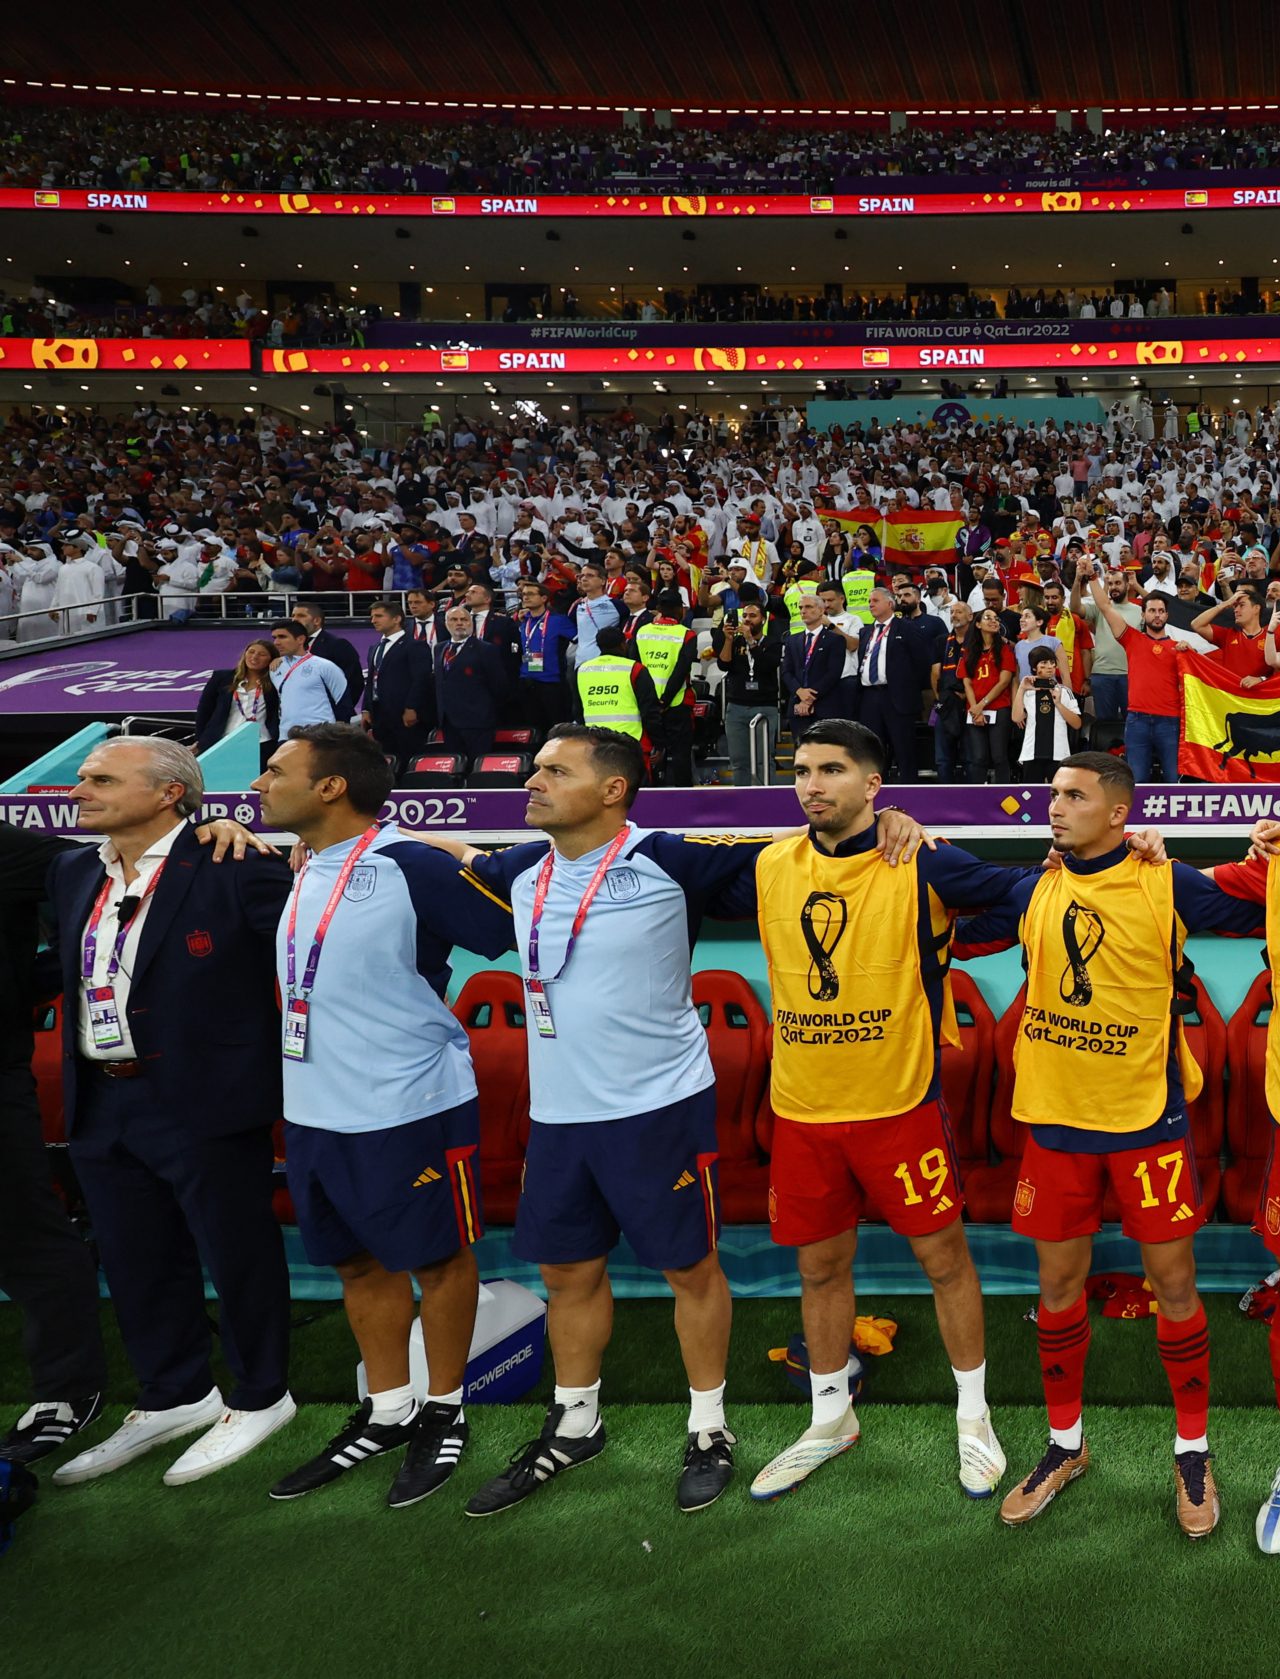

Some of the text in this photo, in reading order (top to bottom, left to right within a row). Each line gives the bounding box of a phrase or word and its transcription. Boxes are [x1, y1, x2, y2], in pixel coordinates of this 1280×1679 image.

[1049, 179, 1057, 187] is
[1058, 178, 1071, 187] all
[87, 194, 147, 208] SPAIN
[482, 199, 537, 212] SPAIN
[859, 198, 913, 211] SPAIN
[530, 327, 638, 341] #FIFAWorldCup
[866, 324, 1069, 339] FIFA WORLD CUP Qatar2022
[500, 353, 565, 368] SPAIN
[920, 349, 984, 365] SPAIN
[588, 685, 619, 695] 2950
[0, 804, 45, 828] IFA
[778, 1009, 891, 1026] FIFA WORLD CUP
[1048, 1012, 1102, 1035] WORLD
[1105, 1023, 1139, 1038] CUP
[780, 1026, 884, 1046] Qatar2022
[894, 1148, 948, 1206] 19
[1134, 1151, 1186, 1210] 17
[467, 1344, 533, 1398] POWERADE
